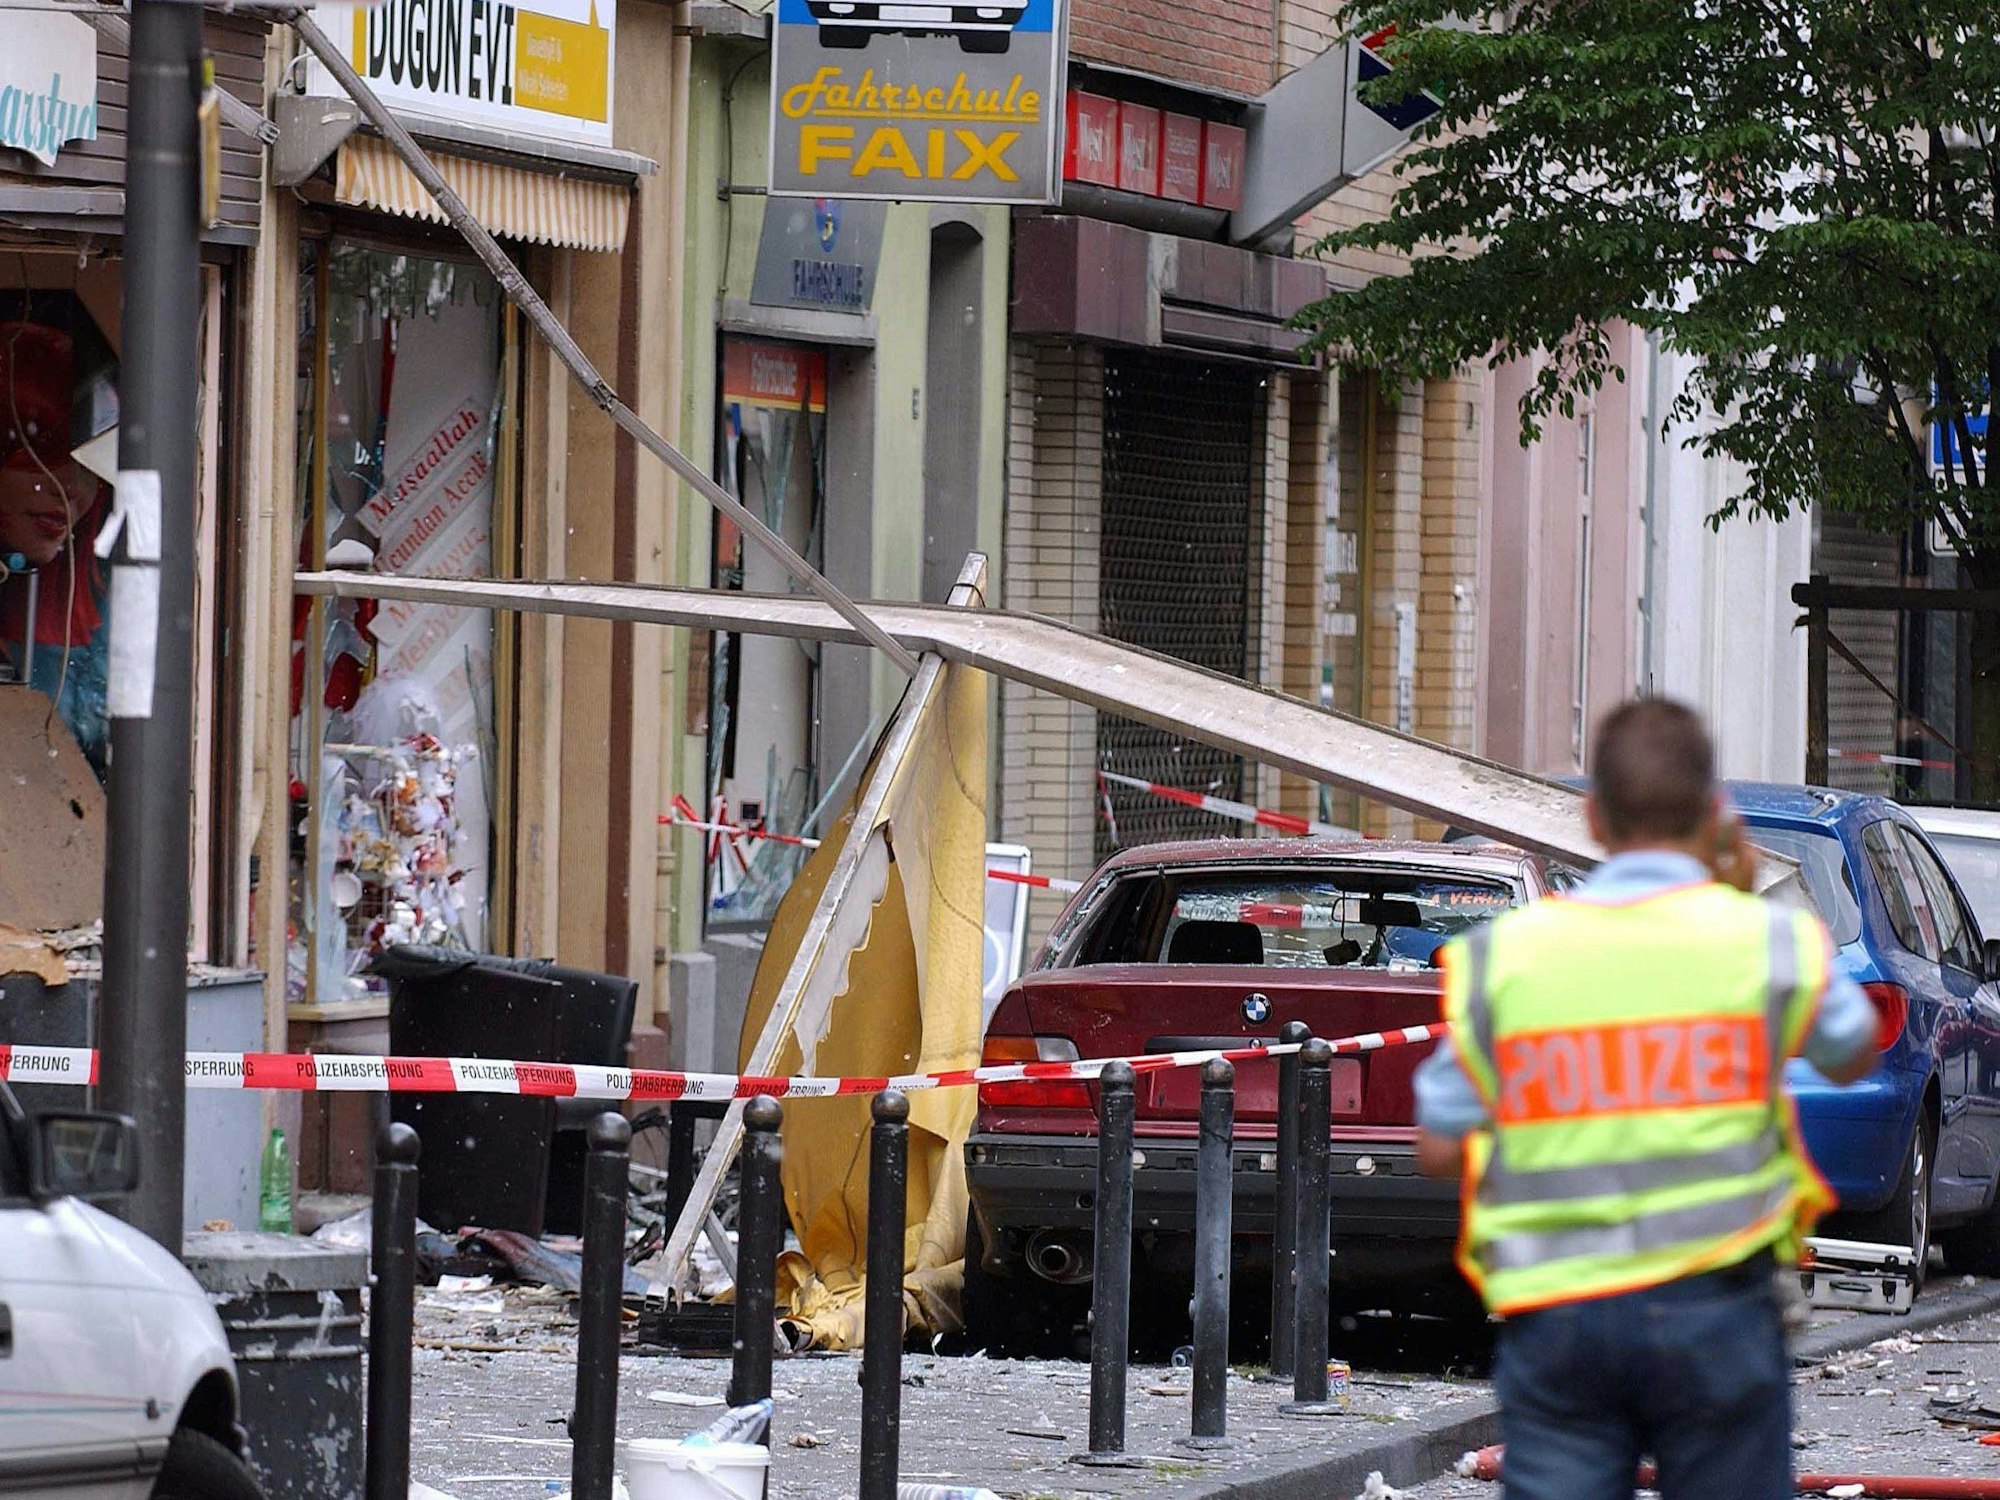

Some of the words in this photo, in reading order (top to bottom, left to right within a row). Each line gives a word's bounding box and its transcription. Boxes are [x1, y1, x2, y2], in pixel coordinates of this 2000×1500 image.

[781, 66, 1040, 119] Fahrschule
[799, 124, 1022, 182] FAIX
[297, 1062, 424, 1079] POLIZEIABSPERRUNG
[461, 1065, 574, 1086] POLIZEIABSPERRUNG
[606, 1073, 704, 1096] POLIZEIABSPERRUNG
[1506, 1022, 1750, 1115] POLIZEI
